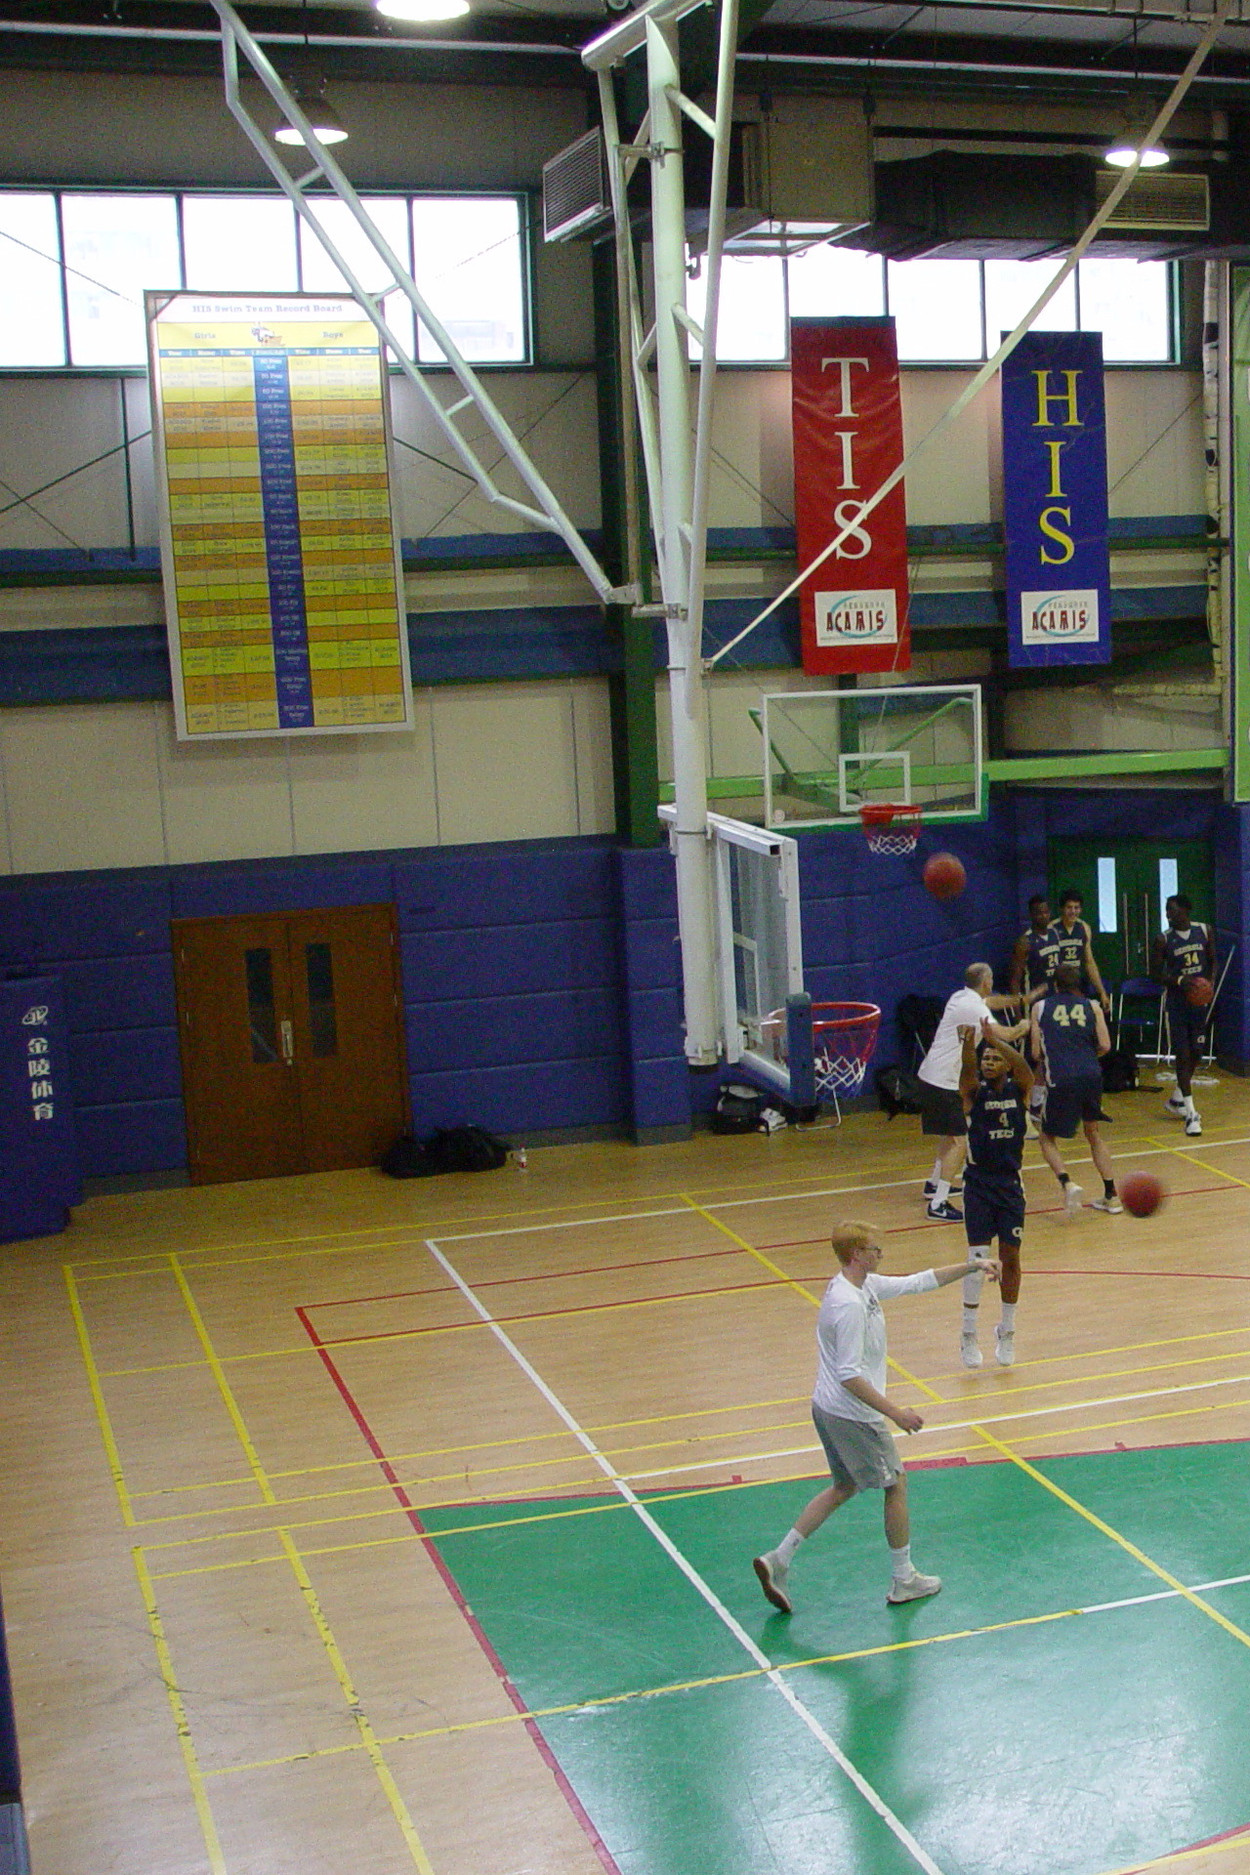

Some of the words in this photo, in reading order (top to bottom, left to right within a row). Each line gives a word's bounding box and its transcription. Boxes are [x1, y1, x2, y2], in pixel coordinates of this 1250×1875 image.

[214, 304, 243, 312] Swim
[246, 304, 273, 312] Team
[276, 304, 310, 312] Record
[313, 304, 343, 312] Board
[821, 357, 872, 561] TIS
[1031, 369, 1083, 565] HIS
[1064, 947, 1077, 960] 32
[1184, 951, 1200, 967] 34
[1052, 1004, 1087, 1027] 44
[27, 1037, 54, 1121] 金陵体育
[999, 1111, 1009, 1127] 4
